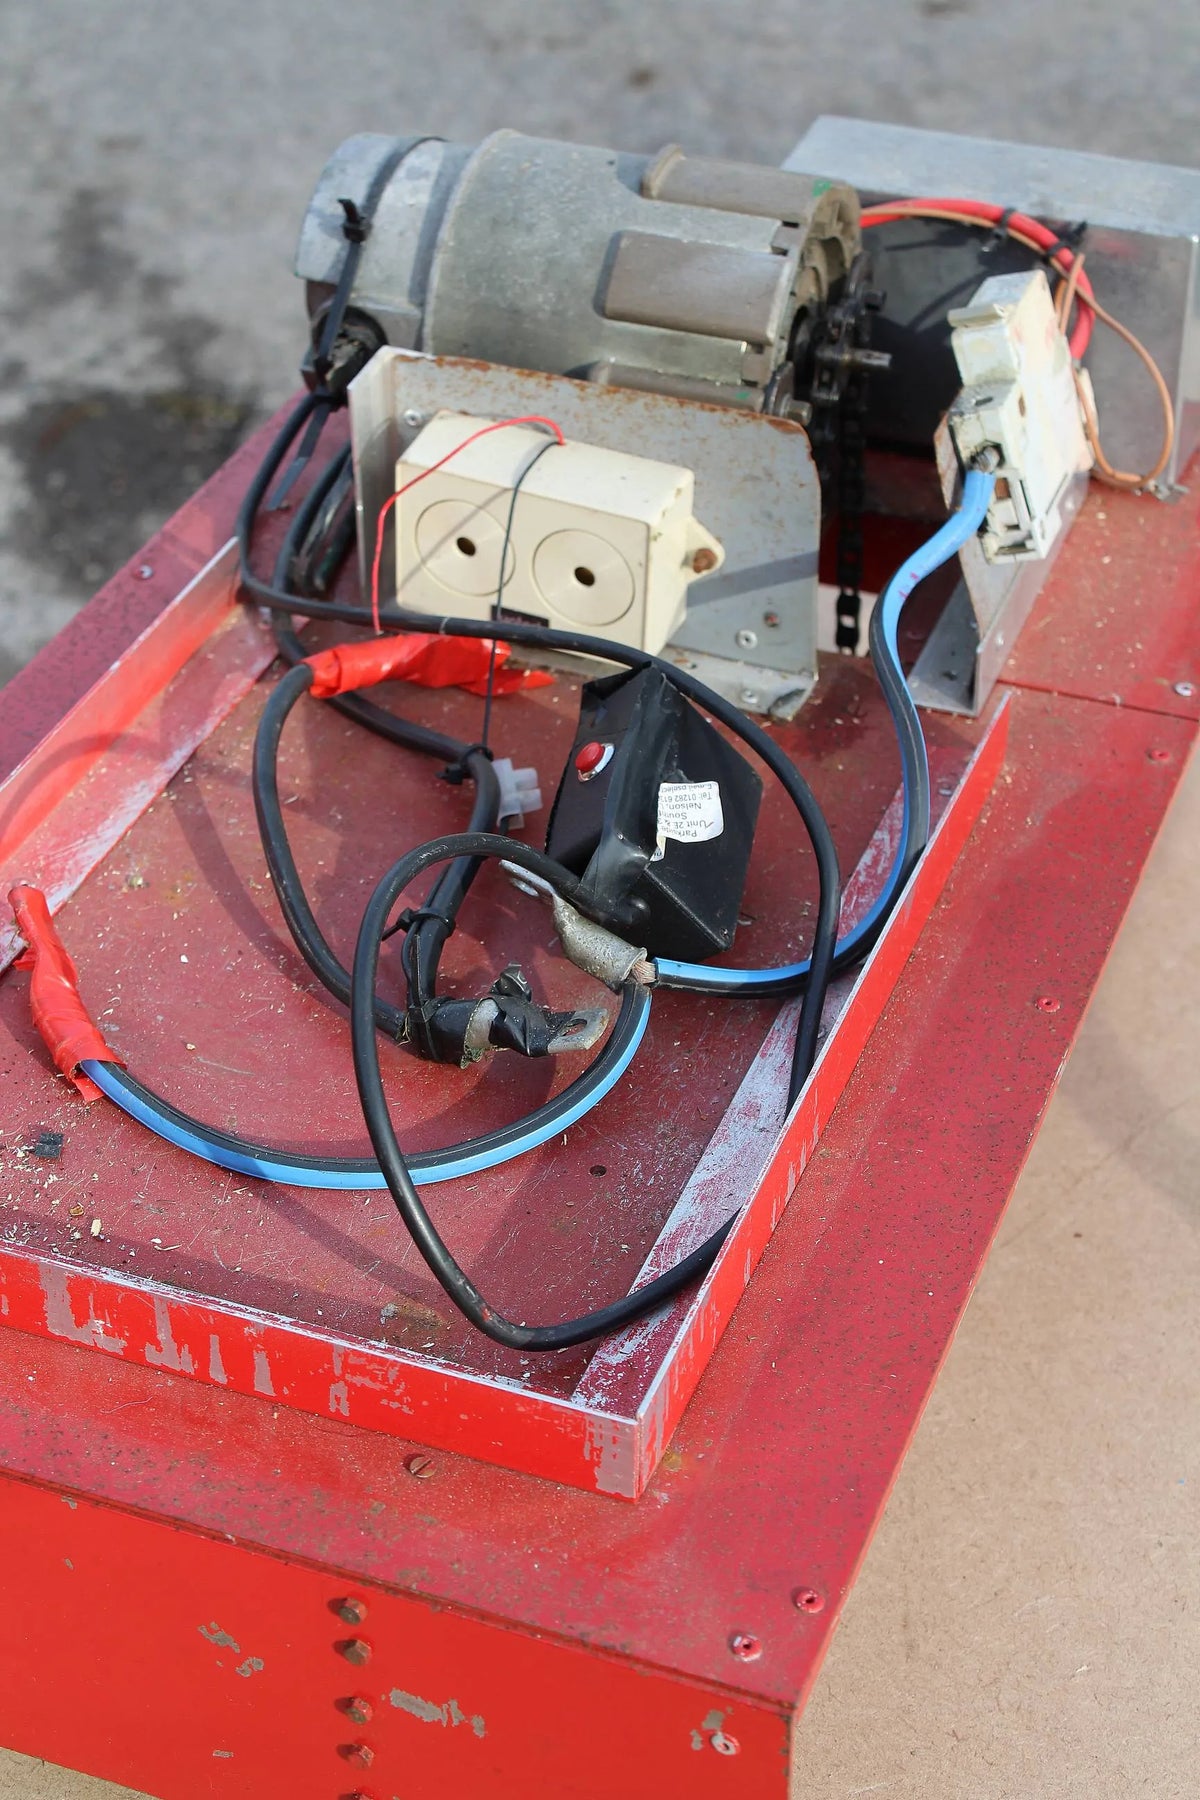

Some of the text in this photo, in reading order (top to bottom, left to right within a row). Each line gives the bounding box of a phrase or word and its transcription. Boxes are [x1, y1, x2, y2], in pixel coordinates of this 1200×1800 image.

[674, 793, 697, 802] 01282
[698, 792, 712, 801] Tel:
[687, 819, 706, 829] Unit
